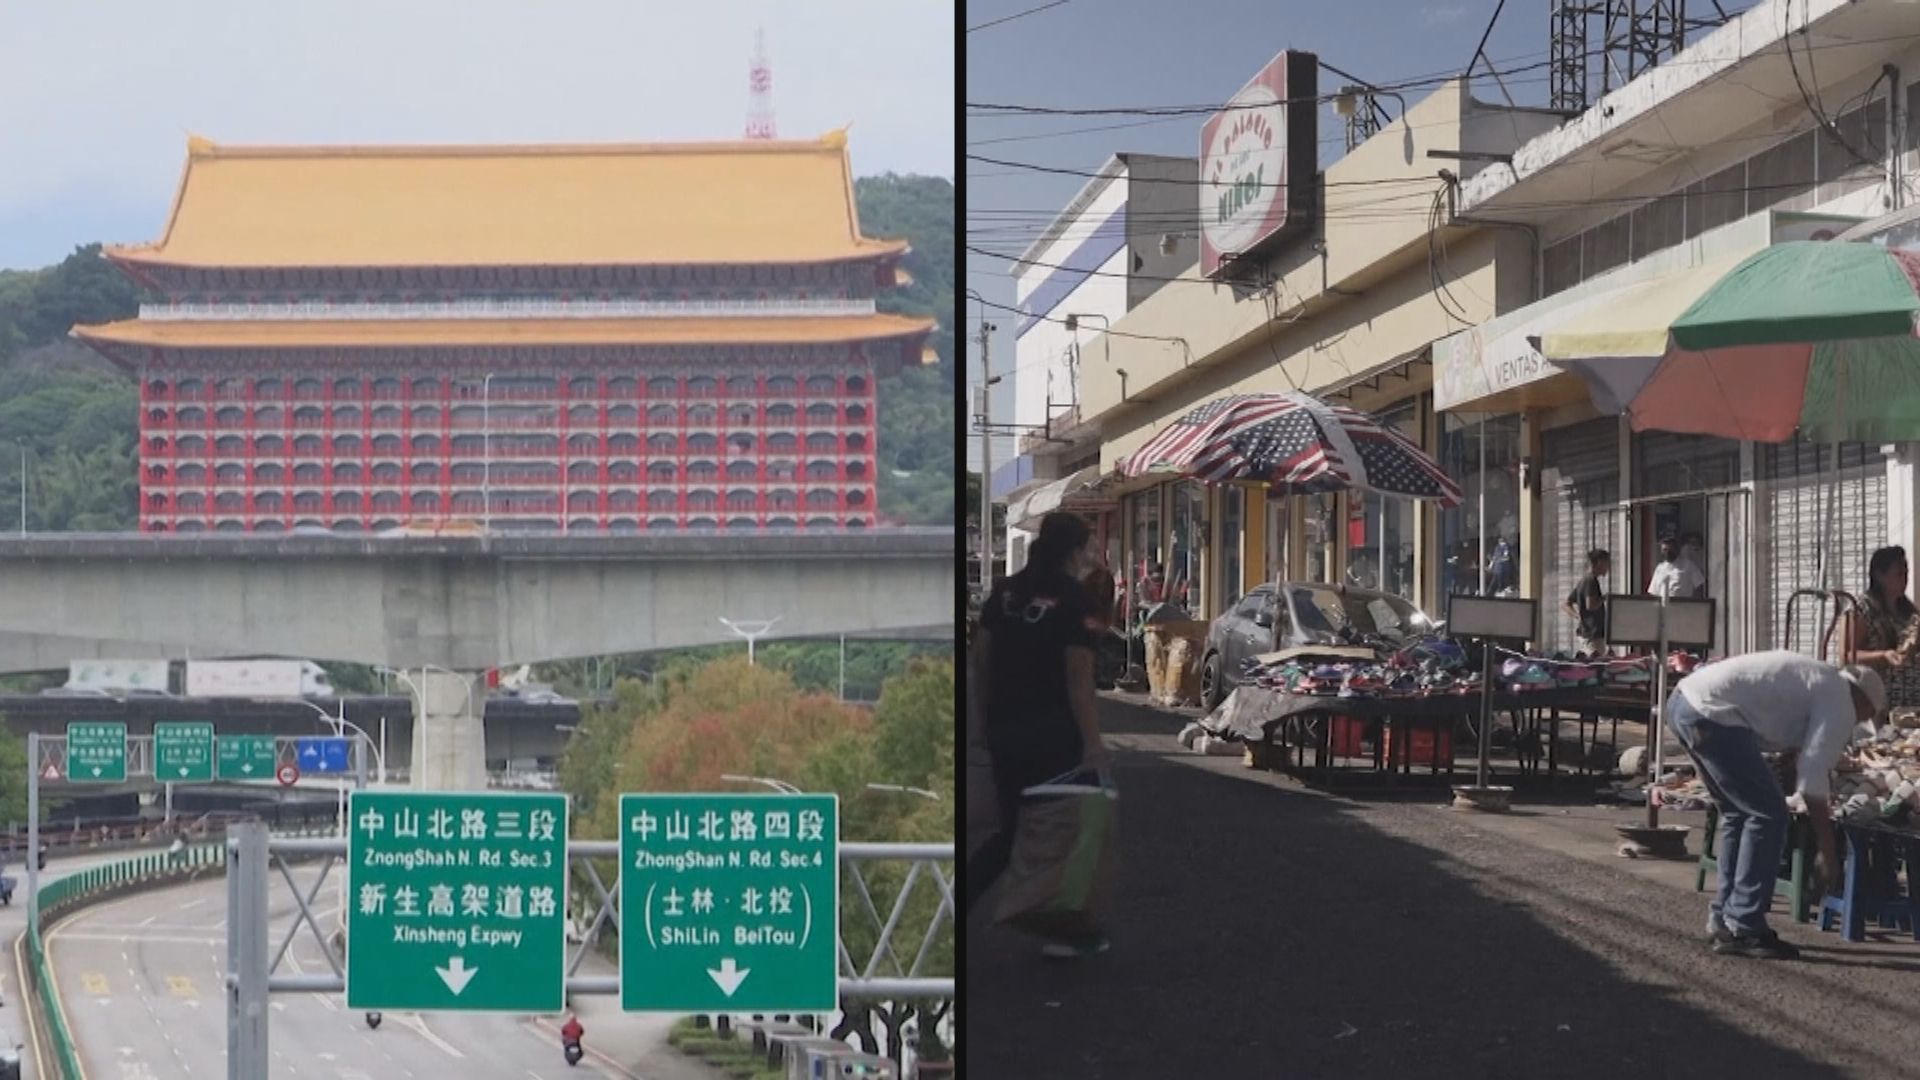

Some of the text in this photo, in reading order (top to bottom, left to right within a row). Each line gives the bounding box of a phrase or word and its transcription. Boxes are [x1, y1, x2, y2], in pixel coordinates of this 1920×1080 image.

[1494, 351, 1539, 384] VENTAS
[360, 806, 556, 841] 中山北路三段
[632, 809, 825, 842] 中山北路四段
[635, 849, 724, 873] ZhongShan
[360, 882, 556, 918] 新生高架道路
[393, 926, 523, 948] Xinsheng Expwy
